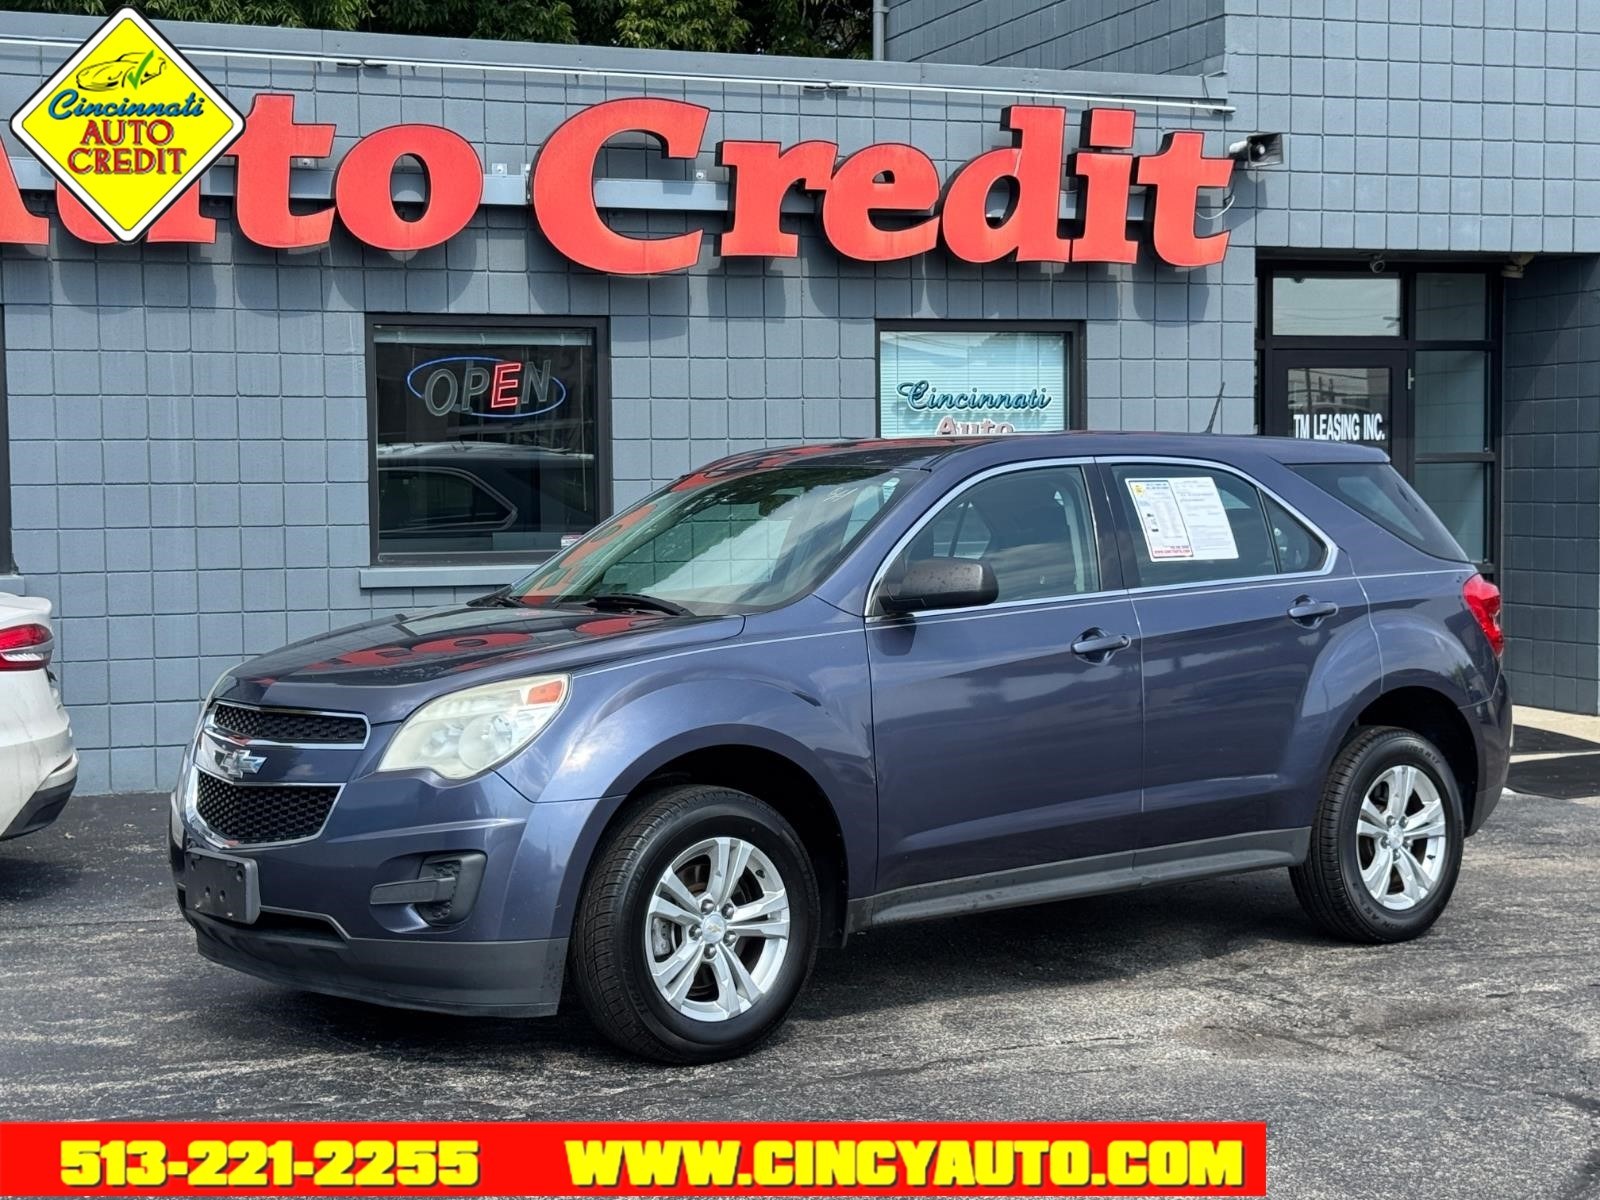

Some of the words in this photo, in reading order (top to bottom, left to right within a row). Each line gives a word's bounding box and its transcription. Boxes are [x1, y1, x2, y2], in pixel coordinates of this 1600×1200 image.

[0, 93, 484, 252] to
[529, 98, 1234, 275] Credit
[424, 360, 551, 416] OPEN
[896, 380, 1052, 412] Cincinnati
[1293, 413, 1310, 439] TM
[1313, 413, 1360, 441] LEASING
[1363, 413, 1386, 441] INC.
